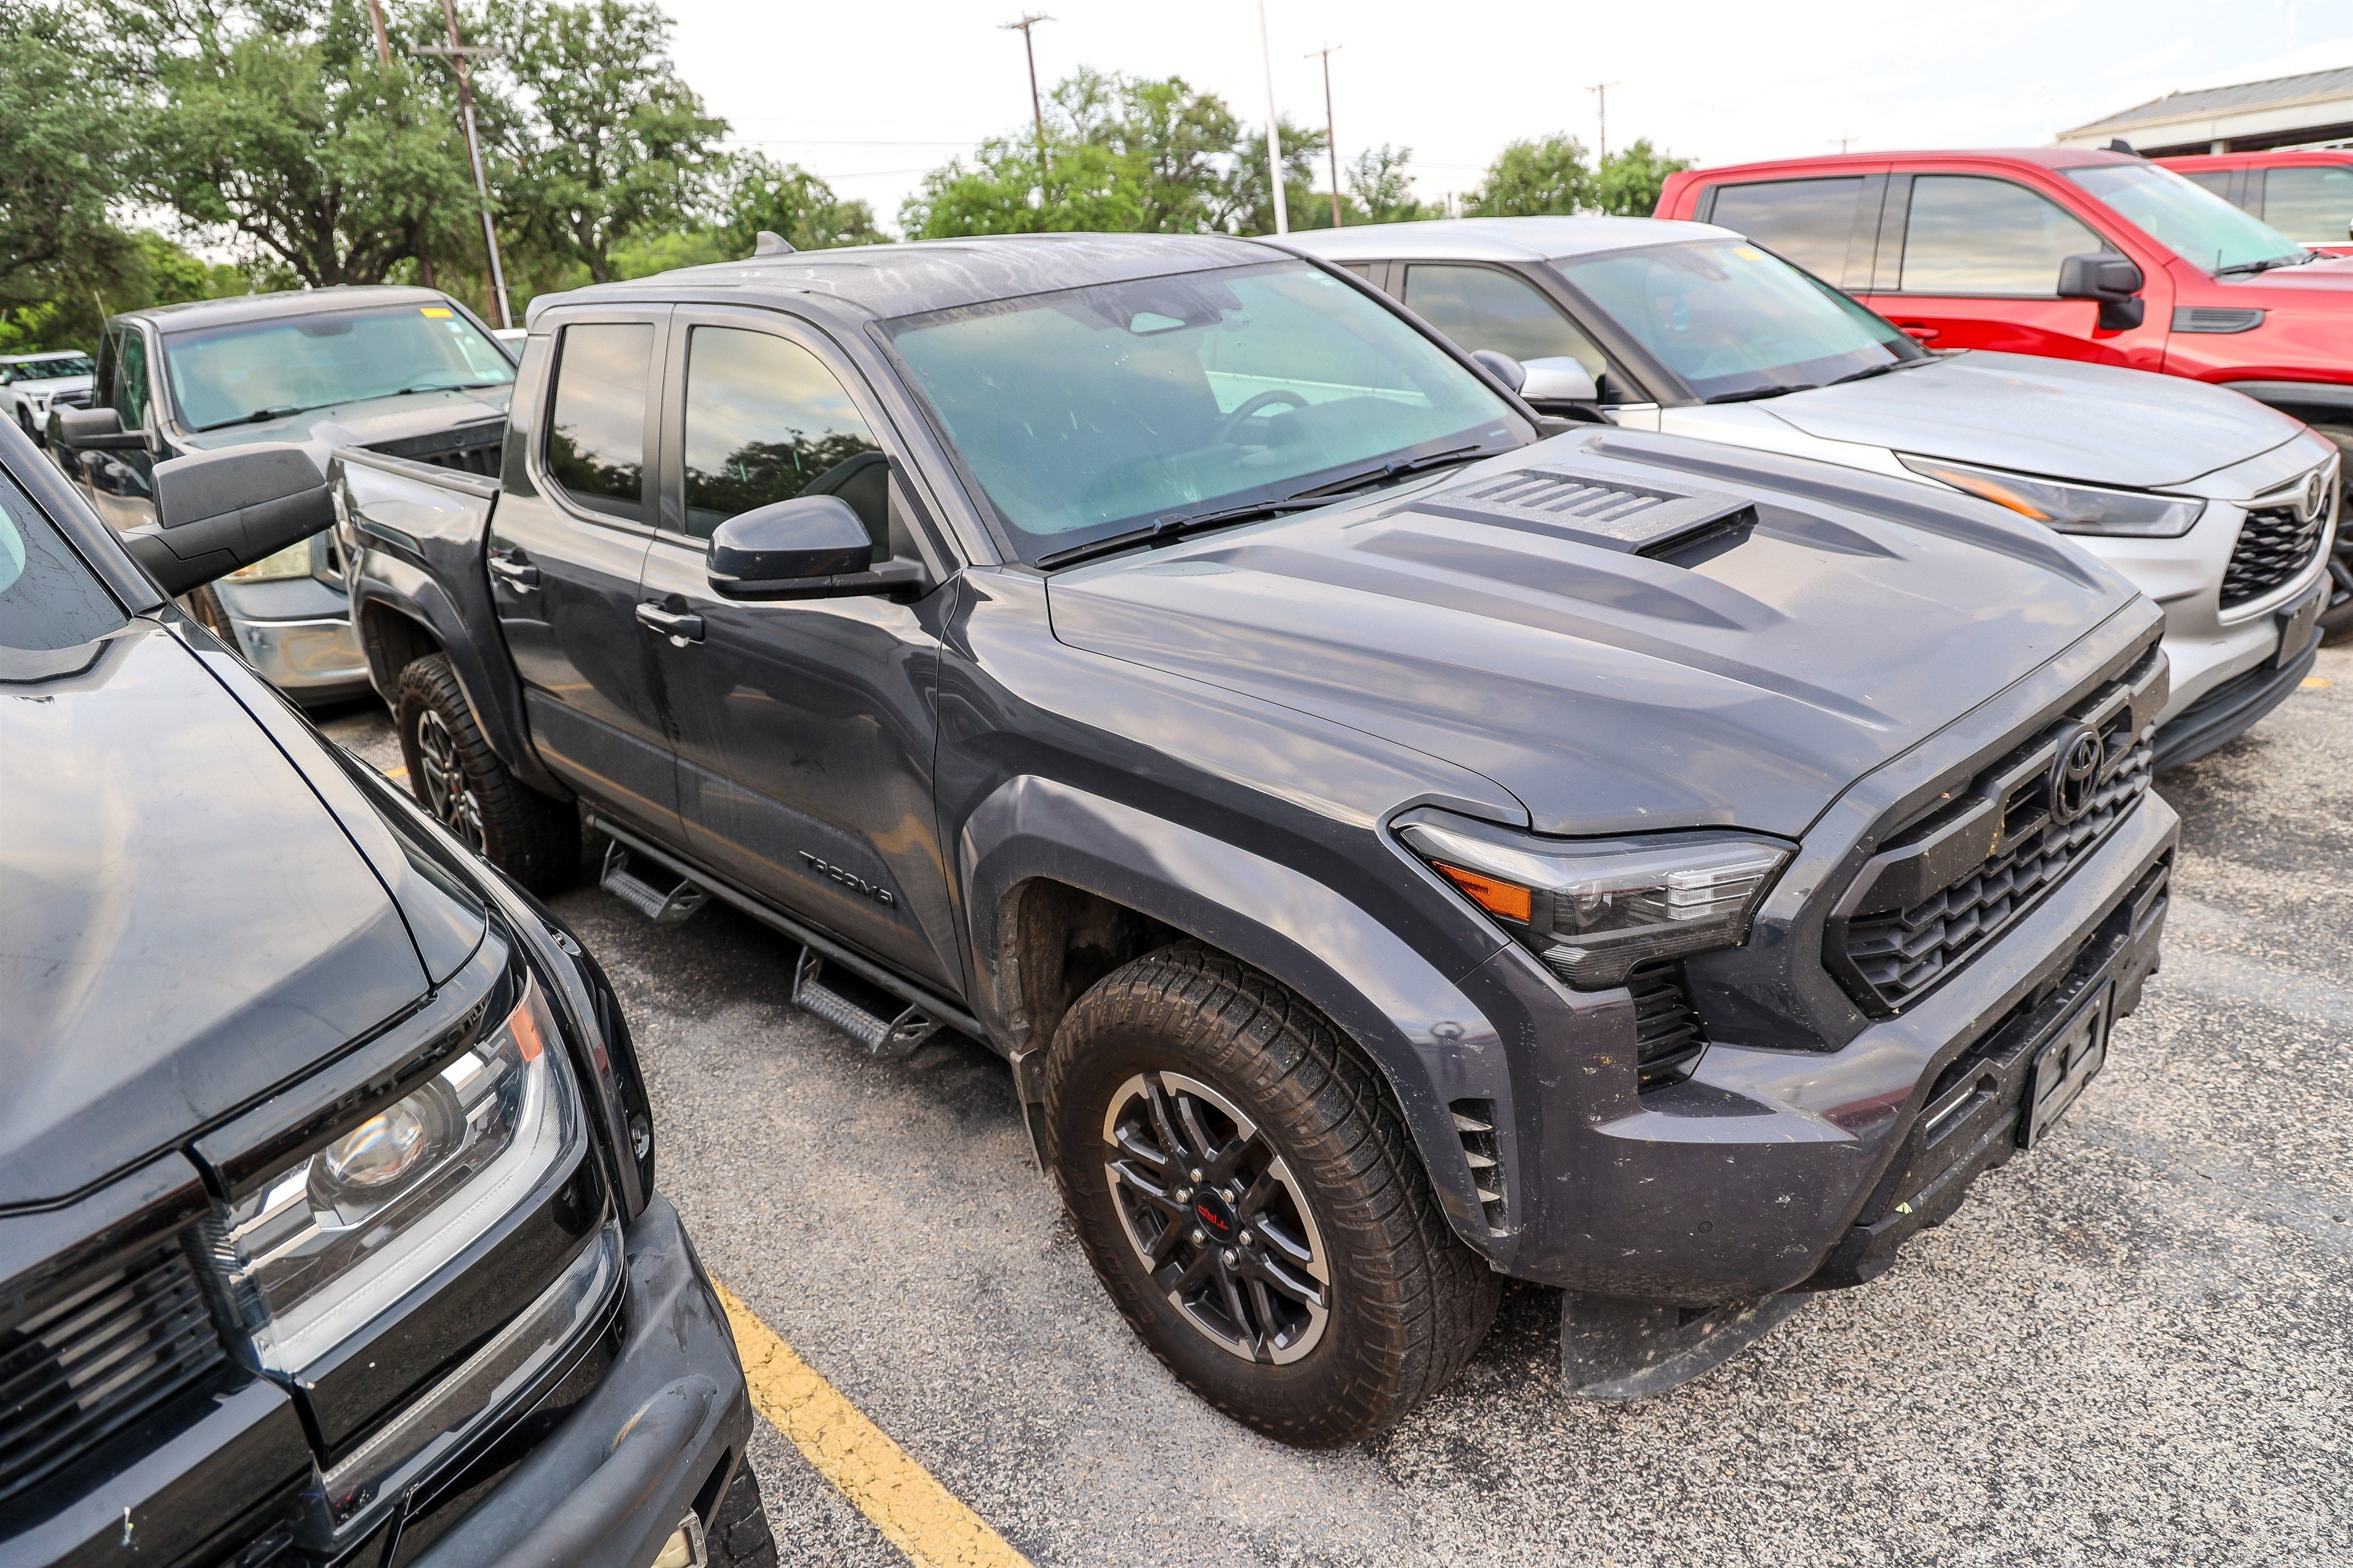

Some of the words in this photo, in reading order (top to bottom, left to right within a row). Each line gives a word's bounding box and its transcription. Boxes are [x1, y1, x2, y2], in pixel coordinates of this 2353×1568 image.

[1461, 848, 1514, 868] TACOMA
[799, 849, 895, 907] TACOMA
[1198, 1204, 1229, 1230] TRD
